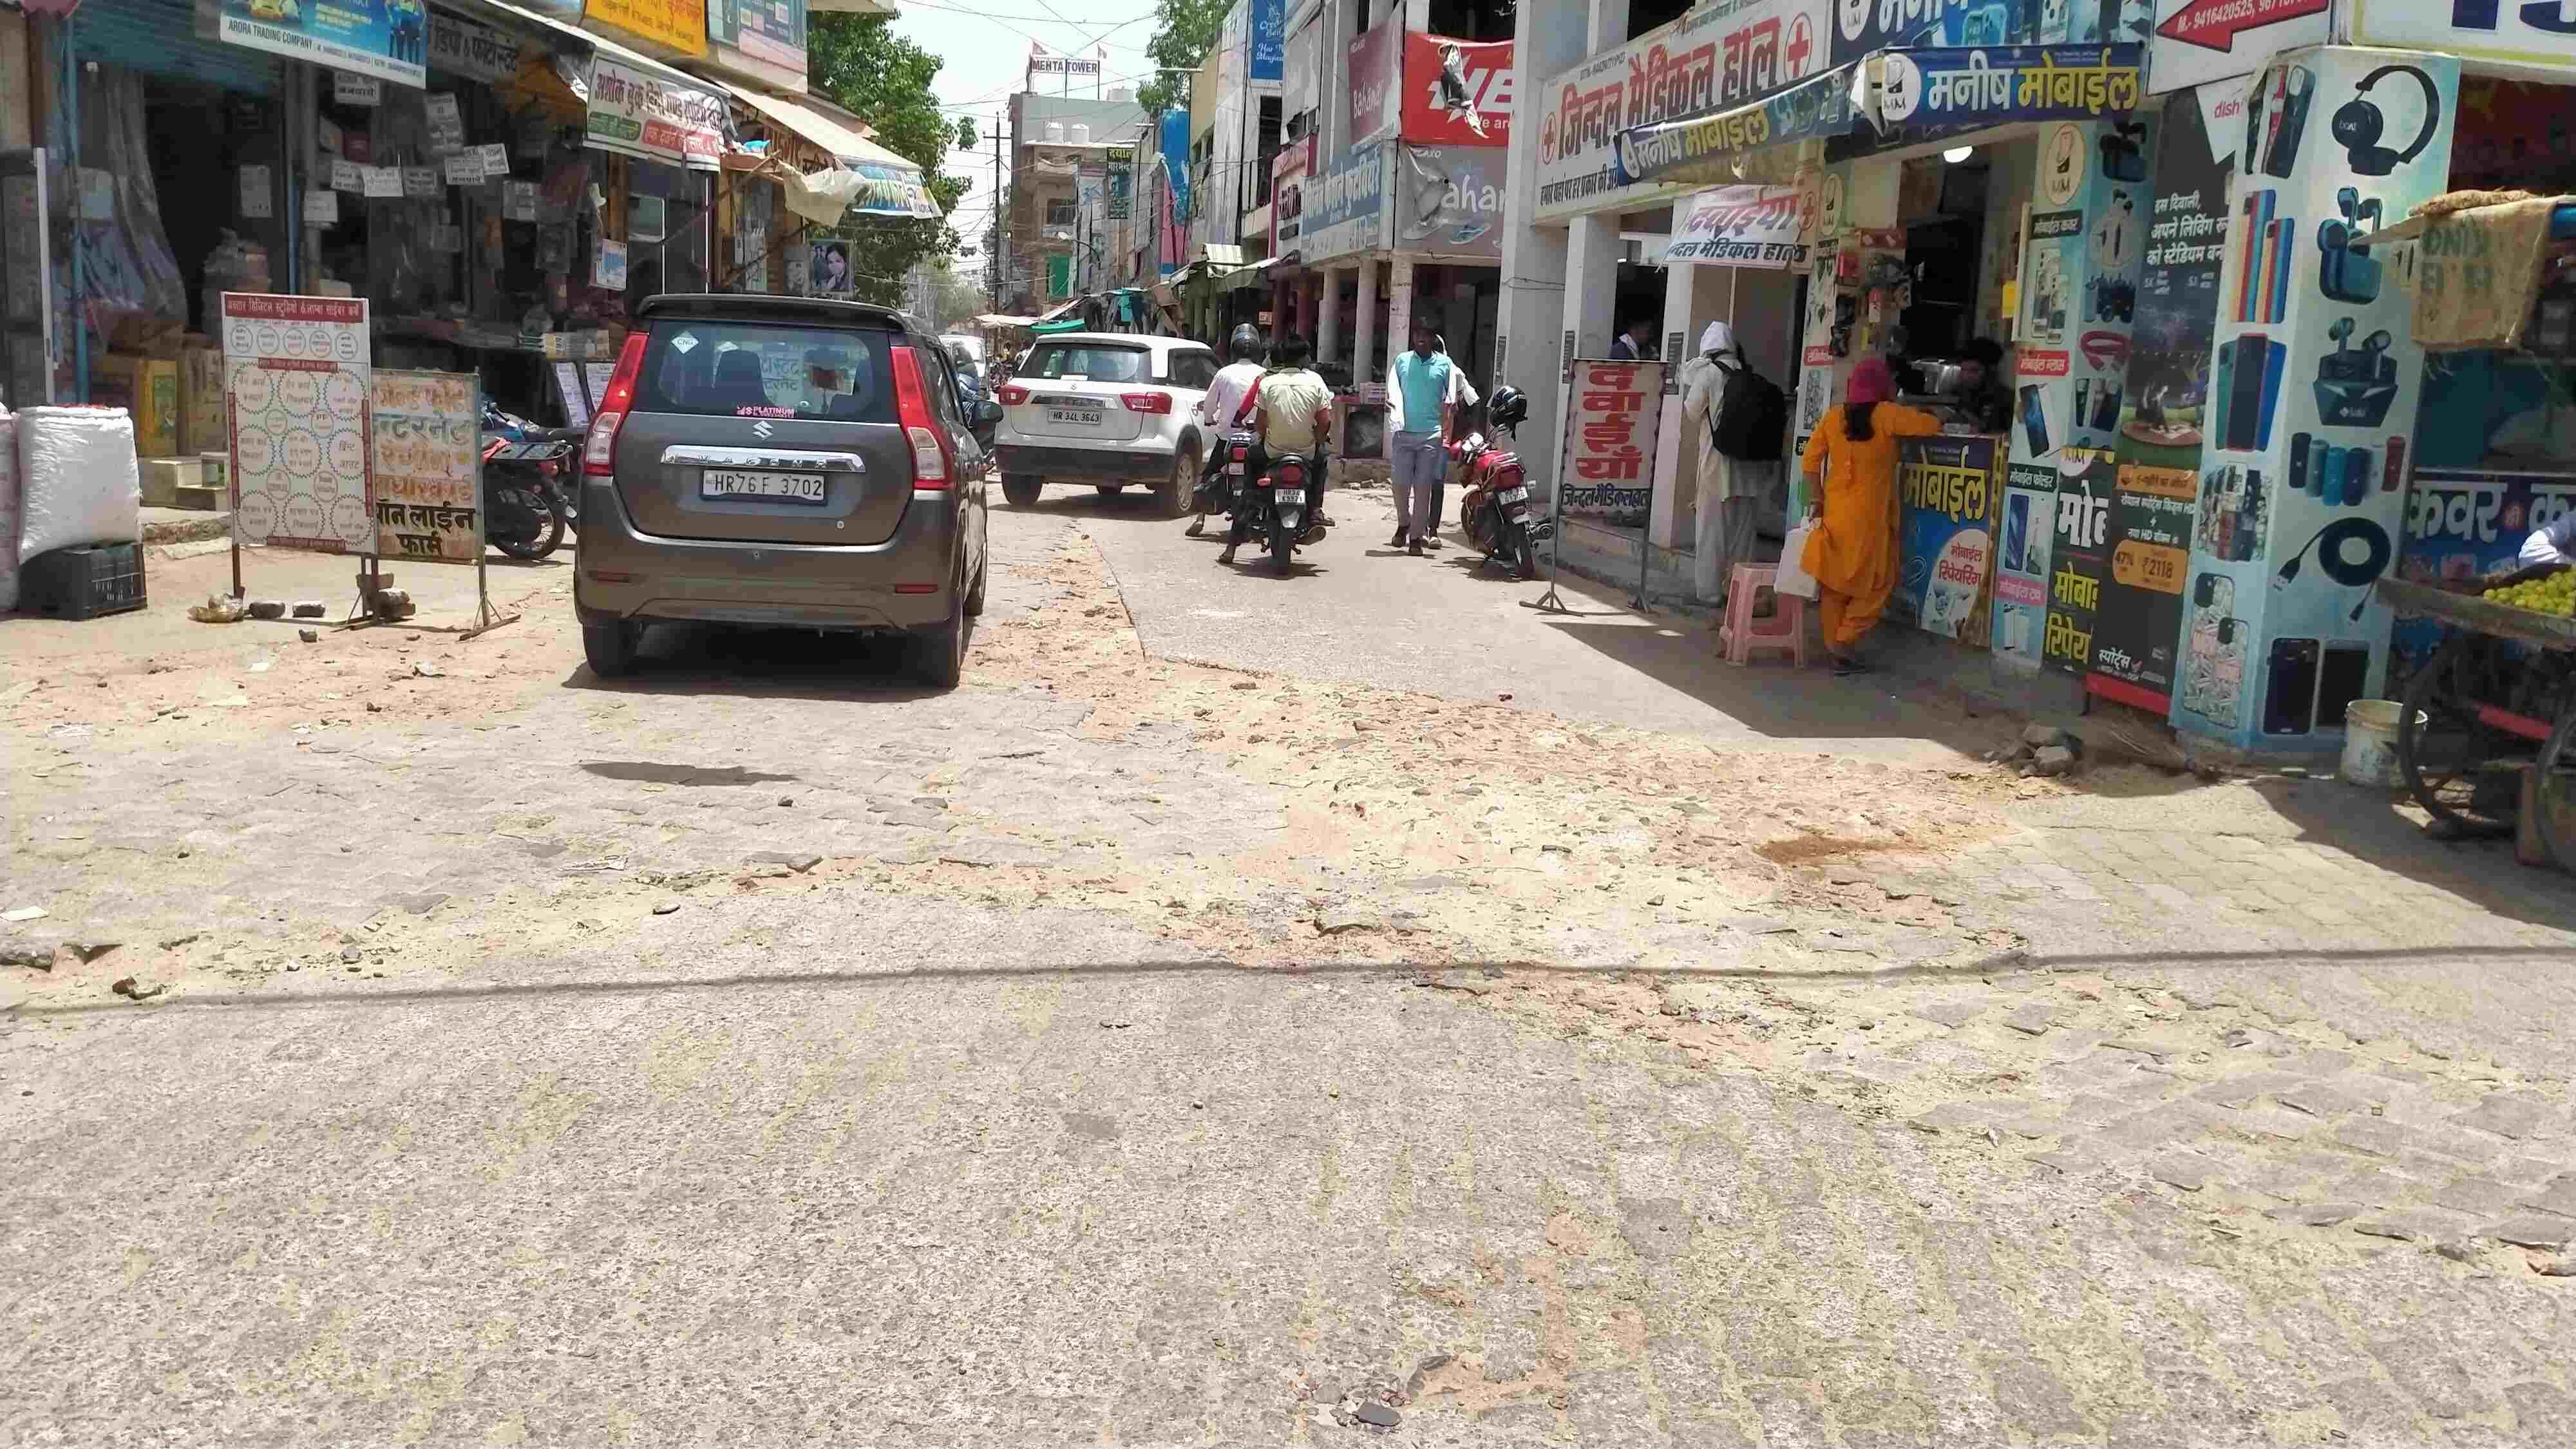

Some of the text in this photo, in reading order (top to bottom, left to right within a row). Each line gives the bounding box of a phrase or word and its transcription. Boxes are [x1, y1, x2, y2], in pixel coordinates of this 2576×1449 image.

[228, 20, 314, 50] ARORA TRADING COMPANY
[1032, 60, 1097, 73] MEHTA TOWER
[595, 68, 625, 104] अशोक
[626, 82, 644, 117] बुक
[1558, 81, 1624, 160] जिन्दल
[1628, 43, 1716, 128] मेडिकल
[1722, 15, 1783, 102] हाल
[1927, 46, 2137, 116] मनीष मोबाईल
[2215, 100, 2239, 118] dish
[2155, 191, 2201, 214] इस दिवाली,
[2151, 216, 2179, 240] अपने
[2179, 211, 2214, 238] लिविंग
[1700, 237, 1763, 259] मेडिकल
[2146, 243, 2162, 266] को
[2163, 241, 2205, 265] स्टेडियम
[753, 406, 795, 416] PLATINUM
[1053, 412, 1063, 421] HR
[714, 474, 756, 493] HR76
[781, 478, 823, 497] 3702
[410, 500, 475, 534] लाईन
[395, 529, 444, 562] फार्म
[1951, 544, 1983, 563] मोबाईल
[2099, 647, 2132, 670] स्पोर्ट्स
